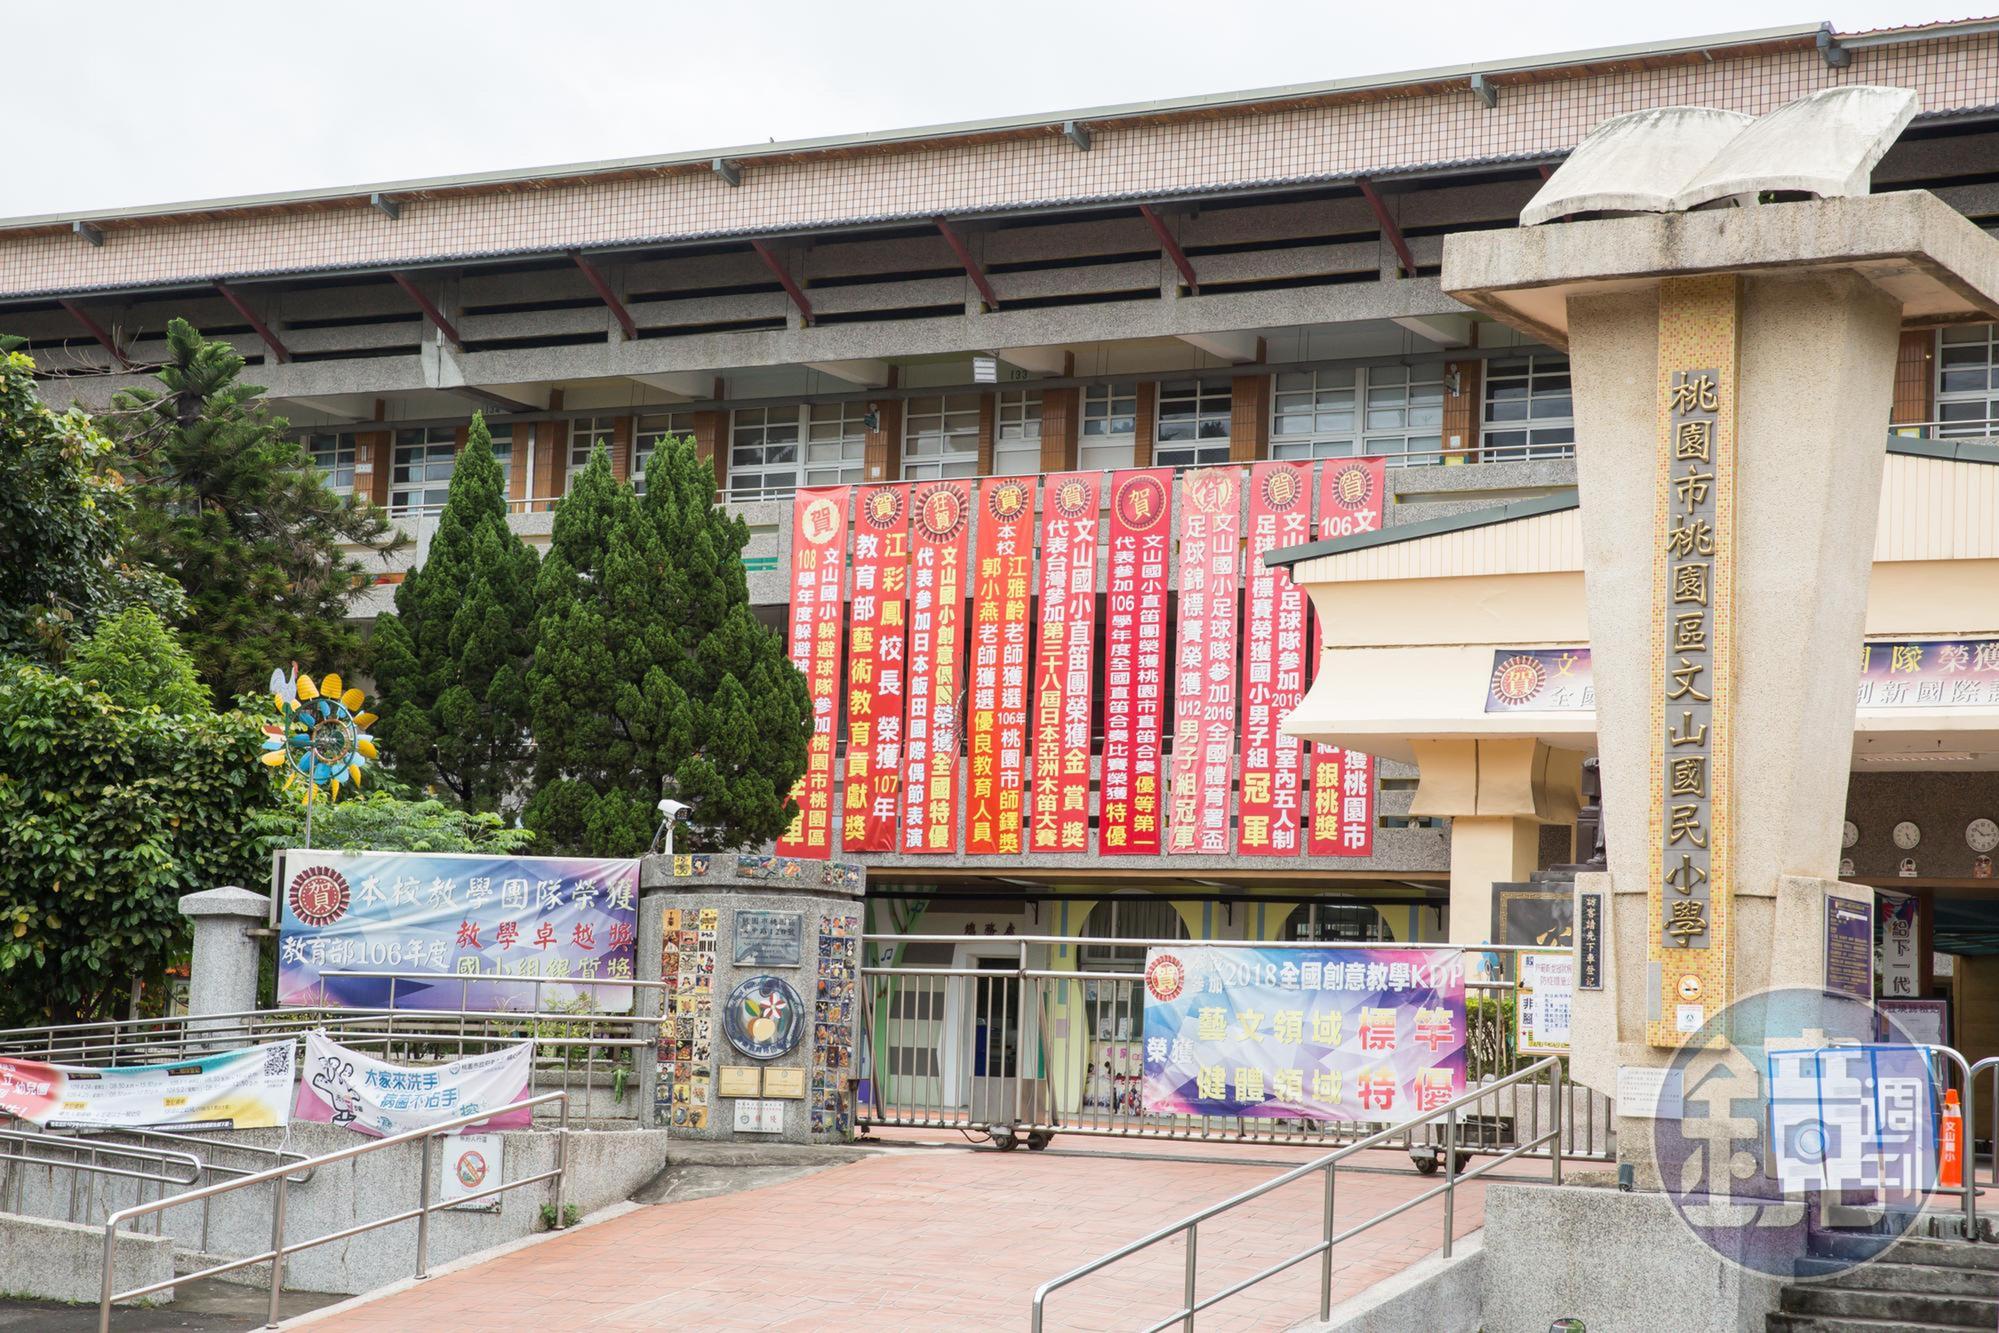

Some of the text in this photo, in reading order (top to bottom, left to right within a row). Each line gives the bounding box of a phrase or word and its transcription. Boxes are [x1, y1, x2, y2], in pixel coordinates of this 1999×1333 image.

[873, 489, 893, 517] 賀
[998, 487, 1018, 513] 賀
[1061, 482, 1083, 507] 賀
[1271, 473, 1292, 503] 賀
[1341, 472, 1363, 503] 賀
[932, 494, 952, 529] 狂賀
[1128, 488, 1151, 520] 賀
[810, 508, 833, 538] 賀
[1353, 508, 1377, 533] 文
[996, 524, 1017, 556] 本校
[1663, 371, 1720, 950] 桃園市桃園區文山國民小學
[845, 533, 879, 841] 教育部藝術教育貢獻獎
[300, 881, 331, 912] 賀
[356, 875, 636, 912] 本校教學團隊榮獲
[281, 936, 450, 968] 教育部106年度
[456, 920, 633, 952] 教學卓越獎
[1197, 1006, 1344, 1047] 藝文領域
[365, 1069, 438, 1091] 大家來洗手
[1195, 1064, 1344, 1105] 健體領域
